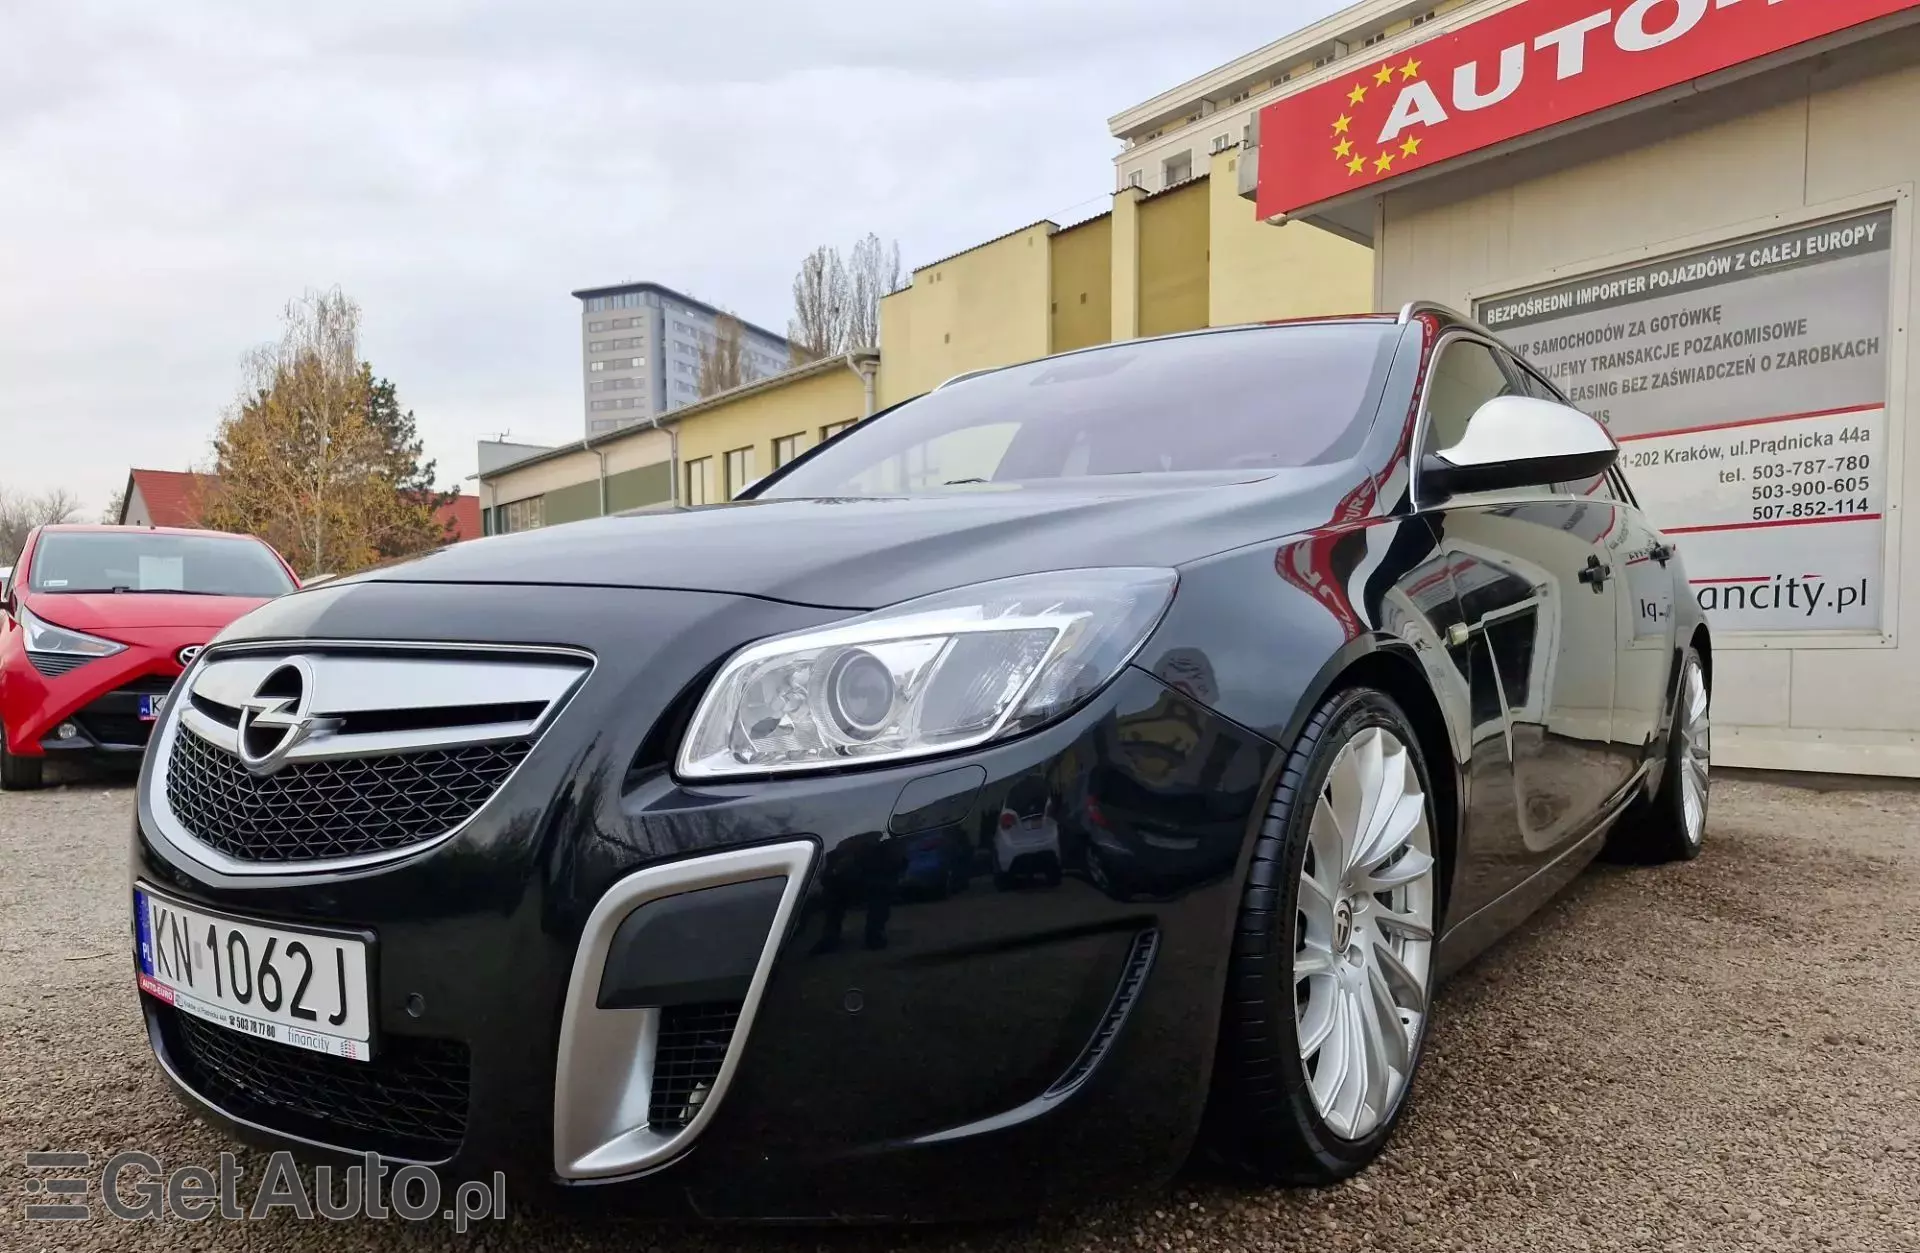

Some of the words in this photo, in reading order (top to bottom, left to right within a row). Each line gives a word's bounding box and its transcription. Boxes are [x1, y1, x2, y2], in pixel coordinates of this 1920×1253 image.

[1487, 292, 1573, 325] BEZPOŚREDNI
[1577, 276, 1646, 305] IMPORTER
[1649, 256, 1731, 289] POJAZDÓW
[1735, 253, 1745, 271] Z
[1749, 240, 1800, 267] CAŁEJ
[1806, 223, 1877, 255] EUROPY
[1532, 323, 1624, 357] SAMOCHODÓW
[1628, 322, 1646, 338] ZA
[1650, 305, 1722, 333] GOTÓWKĘ
[1591, 342, 1679, 371] TRANSAKCJE
[1684, 318, 1807, 356] POZAKOMISOWE
[1621, 375, 1648, 394] BEZ
[1651, 354, 1756, 389] ZAŚWIADCZEŃ
[1761, 355, 1771, 372] O
[1776, 337, 1879, 370] ZAROBKACH
[1618, 450, 1659, 468] 1-202
[1664, 444, 1724, 464] Kraków,
[1730, 432, 1833, 456] ul.Prądnicka
[1839, 426, 1870, 444] 44a
[1719, 468, 1745, 483] tel.
[1752, 454, 1870, 480] 503-787-780
[1752, 476, 1869, 500] 503-900-605
[1752, 497, 1869, 520] 507-852-114
[1697, 574, 1867, 616] ancity.pl
[142, 942, 152, 962] PL
[153, 904, 194, 988] KN
[206, 923, 348, 1026] 1062J
[236, 1015, 249, 1031] 503
[288, 1026, 330, 1053] financity
